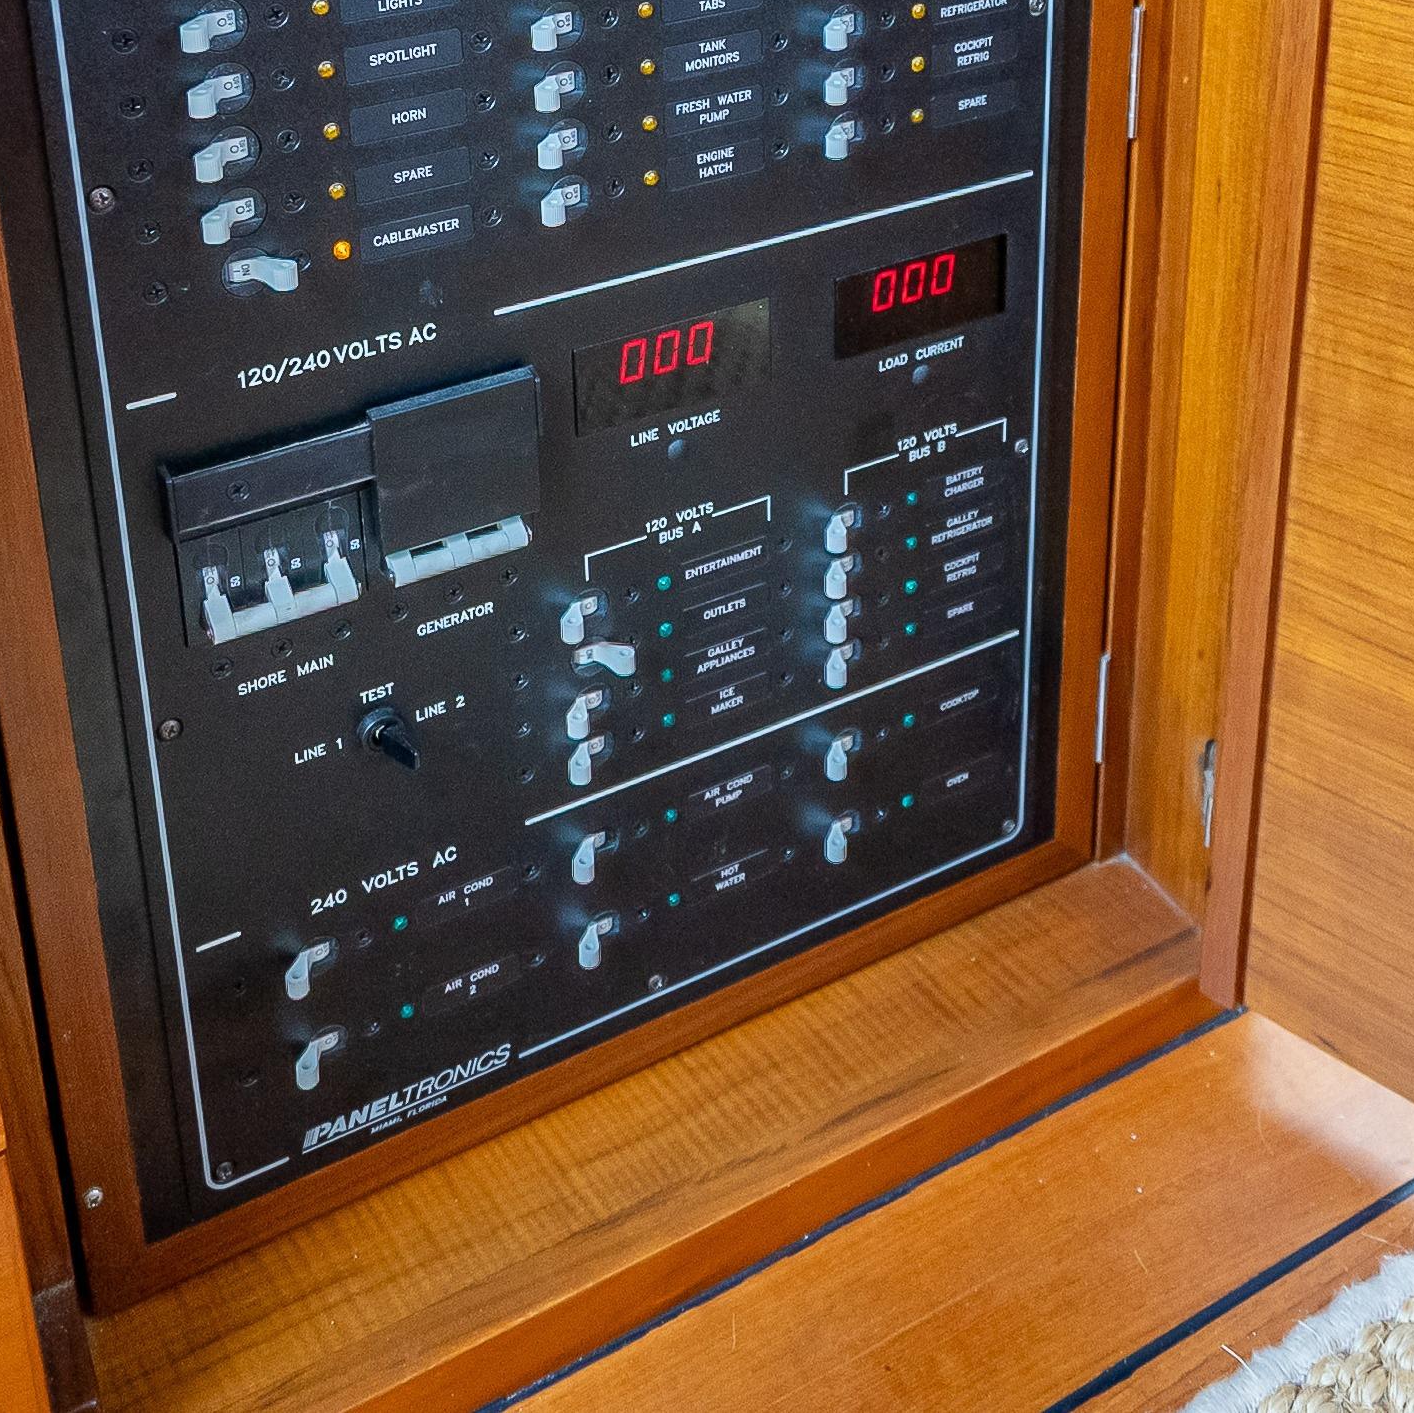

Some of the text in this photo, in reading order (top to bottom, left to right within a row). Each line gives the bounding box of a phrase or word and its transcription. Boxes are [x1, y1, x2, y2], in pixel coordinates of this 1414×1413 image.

[369, 44, 437, 67] SPOTLIGHT
[699, 39, 727, 54] TANK
[954, 36, 994, 53] COCKPIT
[685, 51, 740, 73] MONITORS
[957, 51, 990, 67] REFRIG
[675, 90, 752, 116] FRESH WATER
[958, 95, 987, 111] SPARE
[391, 108, 427, 125] HORN
[699, 109, 730, 125] PUMP
[696, 147, 735, 165] ENGINE
[393, 165, 433, 184] SPARE
[699, 162, 733, 179] HATCH
[373, 218, 460, 247] CABLEMASTER
[871, 251, 955, 314] 000
[236, 322, 438, 390] 120/240 VOLTS AC
[619, 320, 714, 386] 000
[878, 336, 964, 375] LOAD CURRENT
[630, 410, 721, 448] LINE VOLTAGE
[897, 422, 958, 452] 120 VOLTS
[908, 441, 946, 463] BUS B
[945, 465, 984, 486] BATTERY
[944, 476, 984, 498] CHARGER
[645, 501, 714, 534] 120 VOLTS
[946, 508, 979, 528] GALLEY
[659, 521, 702, 544] BUS A
[931, 515, 993, 545] REFRIGERATOR
[685, 545, 763, 580] ENTERTAINMENT
[416, 601, 495, 638] GENERATOR
[703, 598, 746, 620] OUTLETS
[707, 637, 745, 658] GALLEY
[696, 645, 756, 675] APPLIANCES
[237, 654, 335, 697] SHORE MAIN
[359, 682, 396, 704] TEST
[719, 686, 735, 701] ICE
[415, 695, 466, 723] LINE 2
[711, 695, 744, 715] MAKER
[294, 737, 343, 765] LINE 1
[704, 773, 753, 801] AIR COND
[715, 789, 743, 808] PUMP
[310, 845, 458, 916] 240 VOLTS AC
[715, 873, 746, 892] WATER
[720, 864, 740, 879] HOT
[437, 875, 494, 906] AIR COND
[444, 963, 500, 994] AIR COND
[469, 984, 477, 995] 2
[305, 1043, 512, 1149] PANELTRONICS
